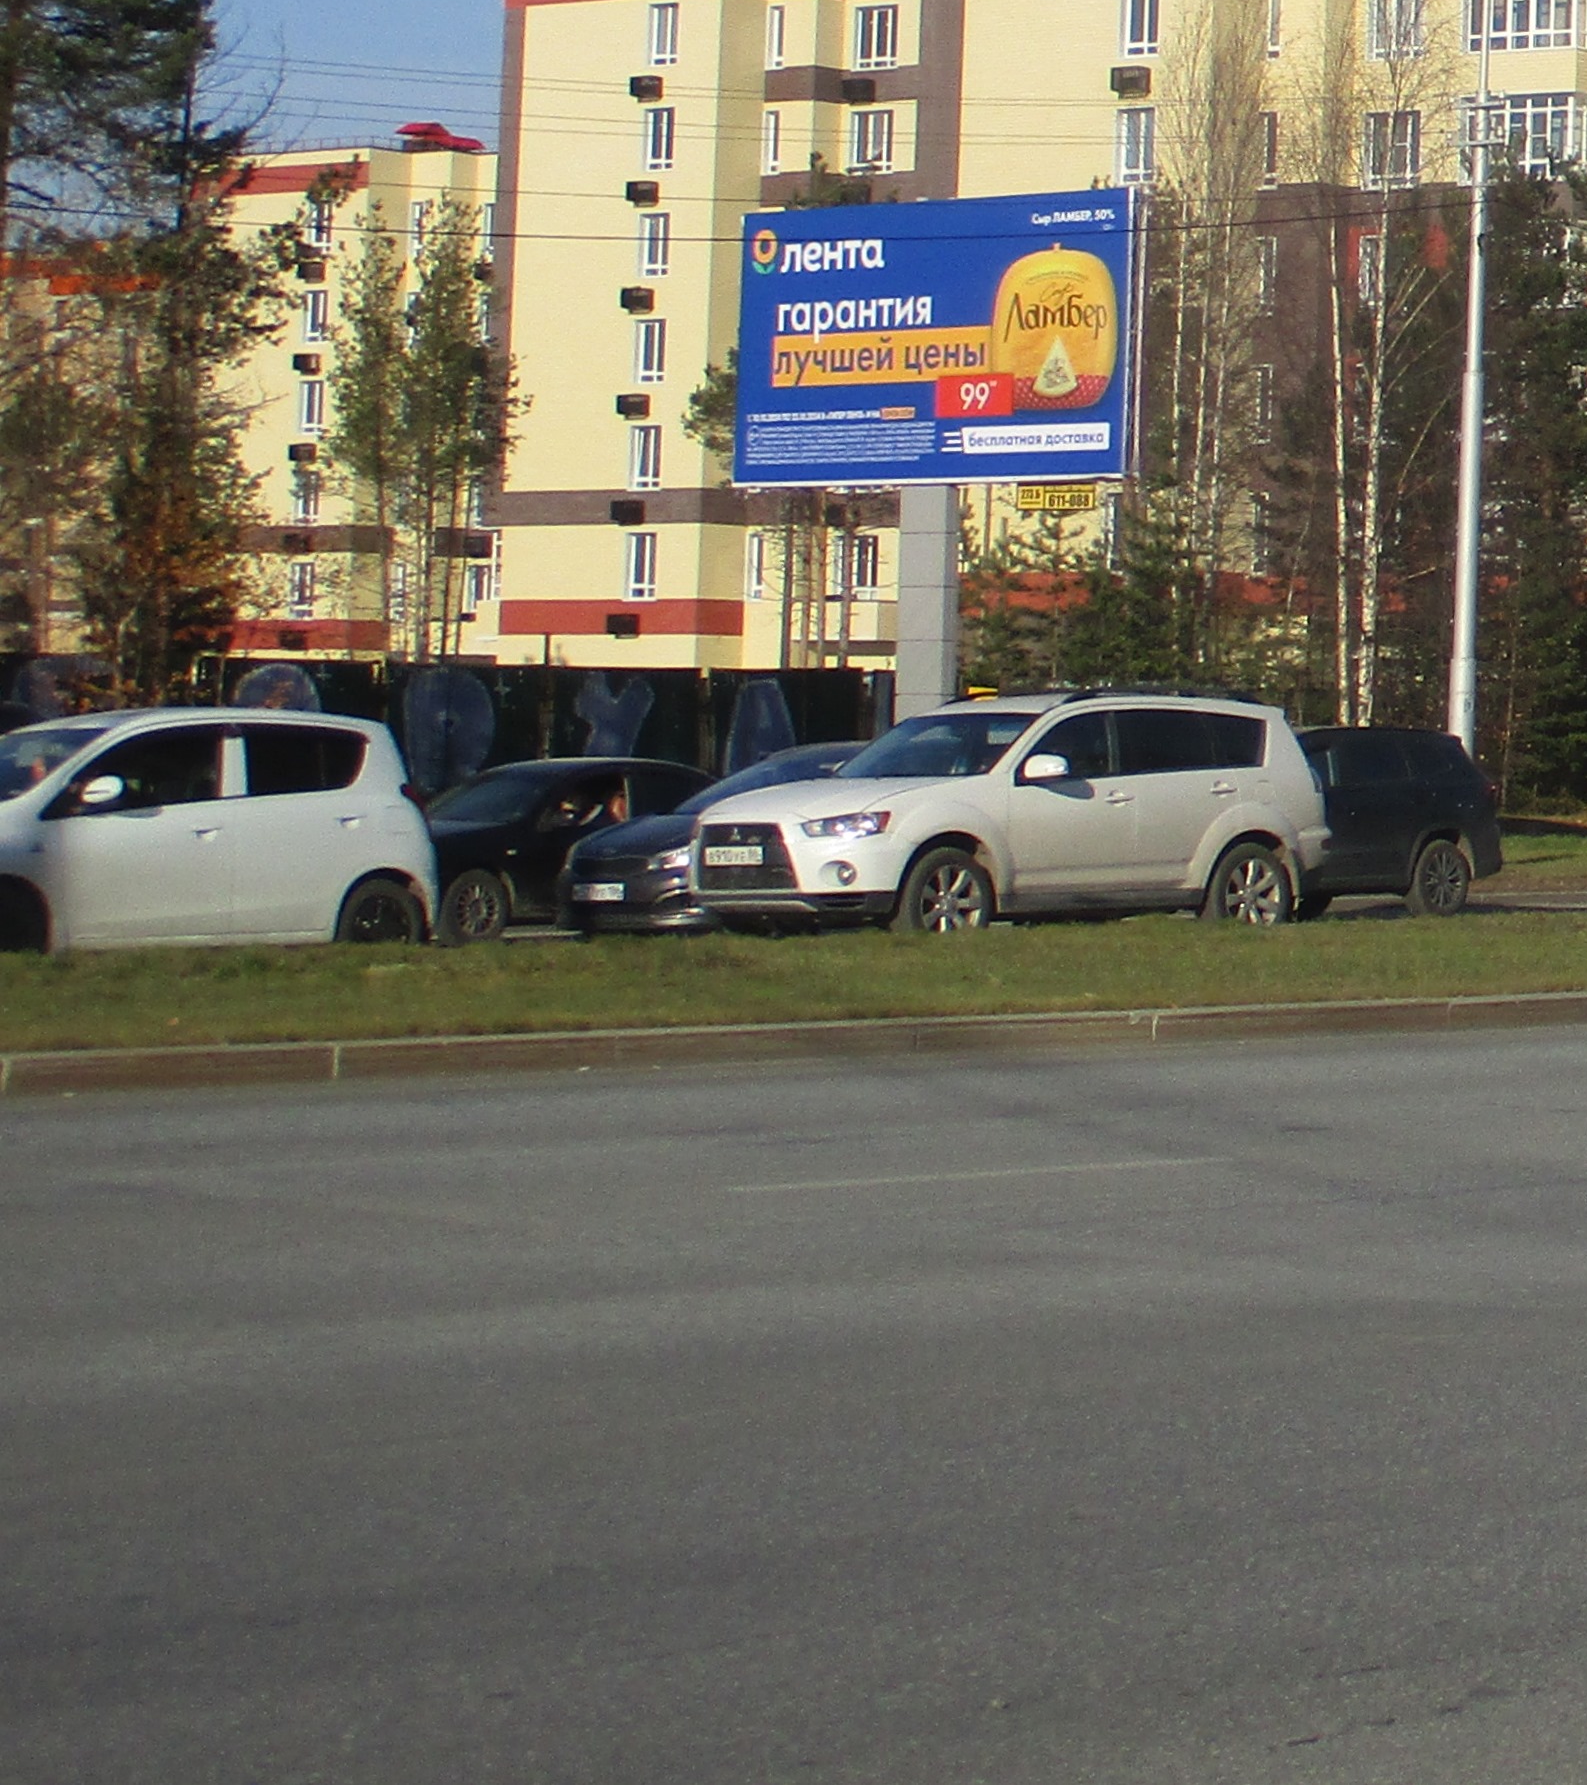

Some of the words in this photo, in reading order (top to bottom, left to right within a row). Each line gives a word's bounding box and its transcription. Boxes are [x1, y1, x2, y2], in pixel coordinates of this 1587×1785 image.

[780, 239, 885, 274] лента
[777, 295, 932, 344] гарантия
[1004, 292, 1107, 342] Ламбер
[774, 336, 893, 385] лучшей
[904, 342, 985, 375] цены
[968, 432, 1042, 447] бесплатная
[1044, 432, 1104, 446] доставка
